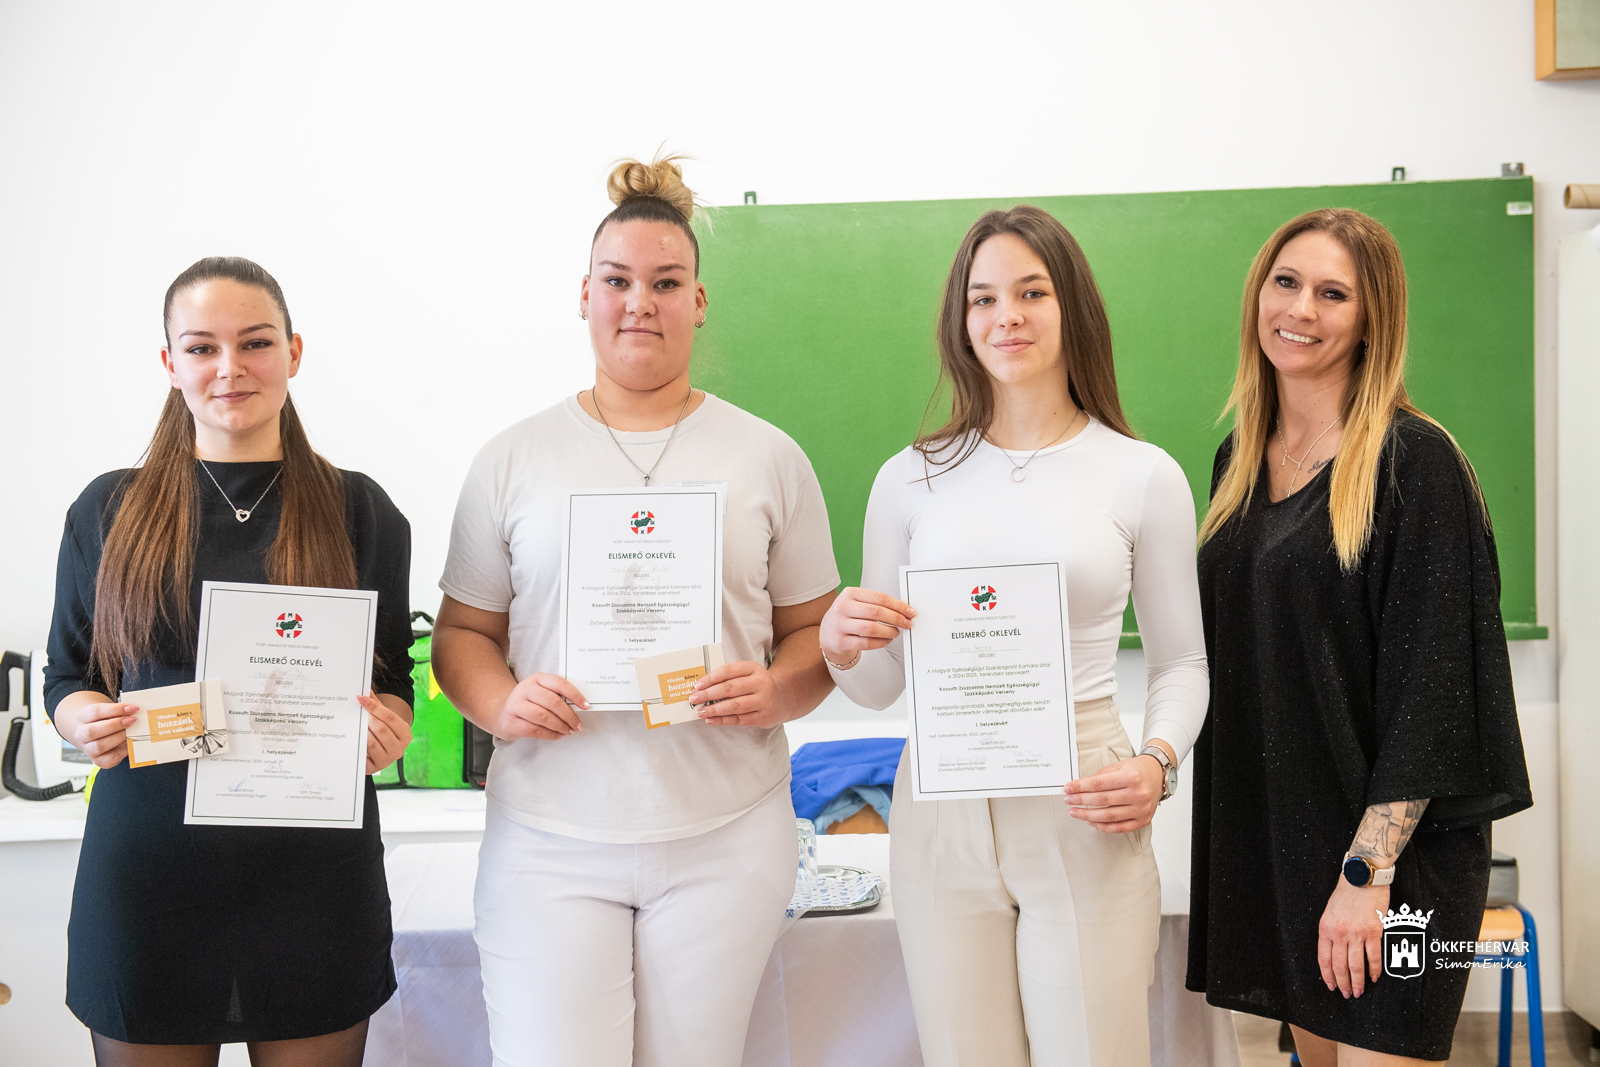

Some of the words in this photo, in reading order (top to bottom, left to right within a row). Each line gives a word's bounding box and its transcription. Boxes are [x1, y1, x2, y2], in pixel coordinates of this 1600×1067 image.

[608, 551, 643, 559] ELISMERŐ
[645, 551, 676, 559] OKLEVÉL
[952, 629, 986, 639] ELISMERŐ
[990, 627, 1021, 637] OKLEVÉL
[250, 656, 287, 664] ELISMERŐ
[290, 658, 323, 667] OKLEVÉL
[157, 717, 194, 728] hozzánk
